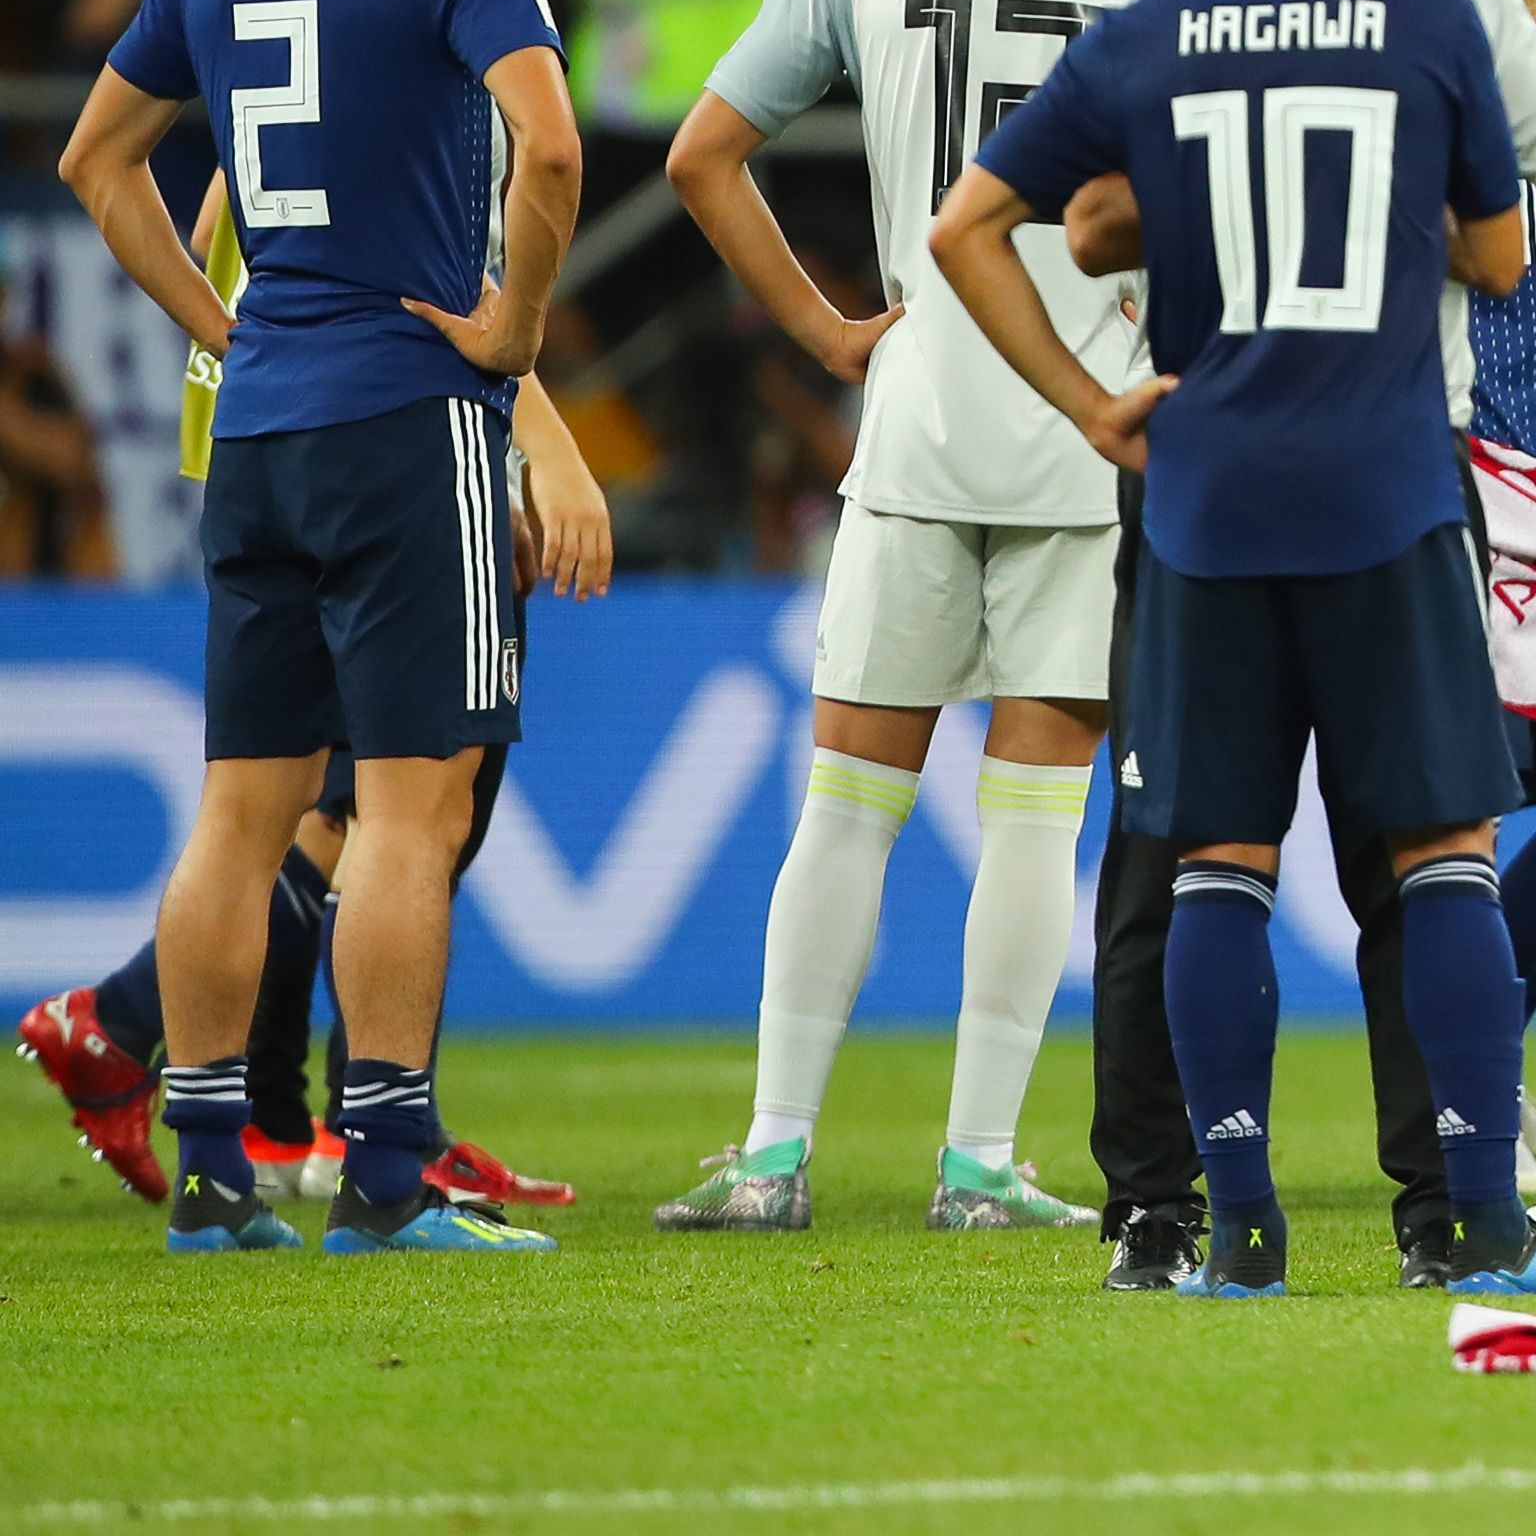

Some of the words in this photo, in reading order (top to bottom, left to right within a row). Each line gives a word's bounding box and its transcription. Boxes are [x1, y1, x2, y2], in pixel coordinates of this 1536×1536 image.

[1178, 0, 1387, 56] KAGAWA
[231, 0, 331, 228] 2
[1171, 86, 1398, 334] 10
[1206, 1125, 1263, 1141] adidas
